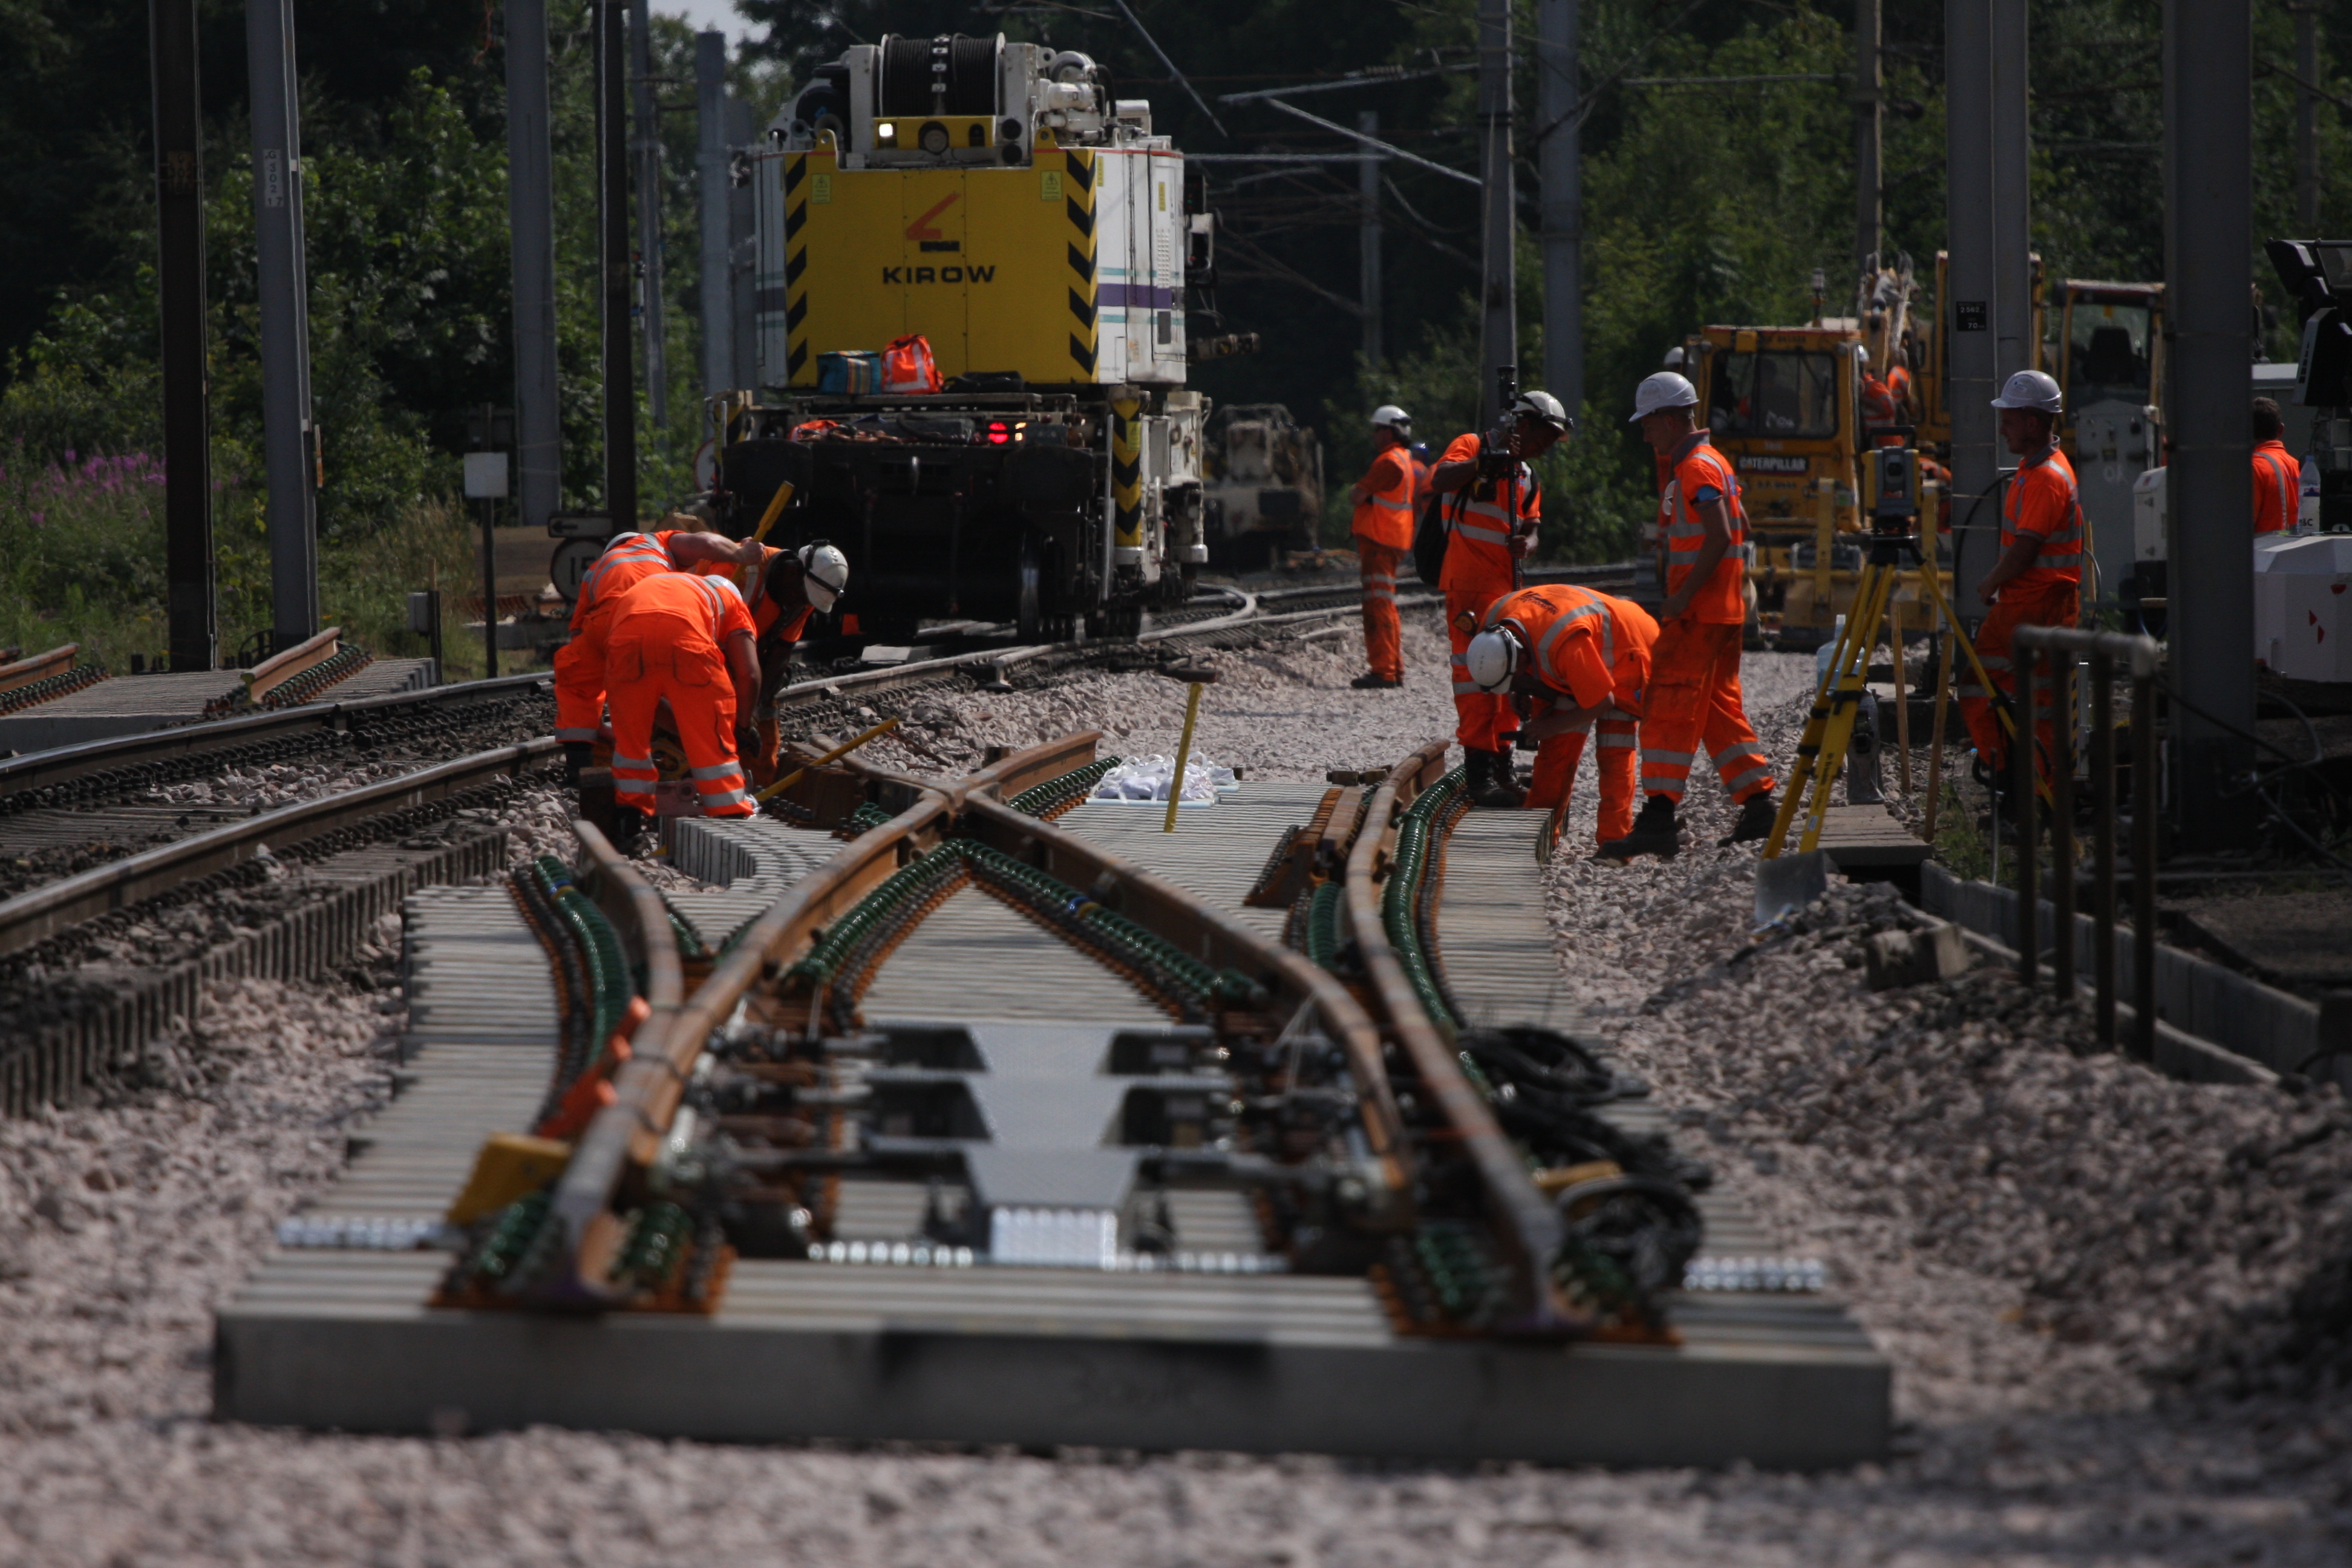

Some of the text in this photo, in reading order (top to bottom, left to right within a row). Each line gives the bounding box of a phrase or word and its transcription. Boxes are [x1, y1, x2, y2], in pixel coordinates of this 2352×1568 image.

[269, 151, 277, 159] G
[267, 197, 283, 206] 17
[883, 266, 995, 284] KIROW
[1738, 456, 1806, 472] CATERPILLAR
